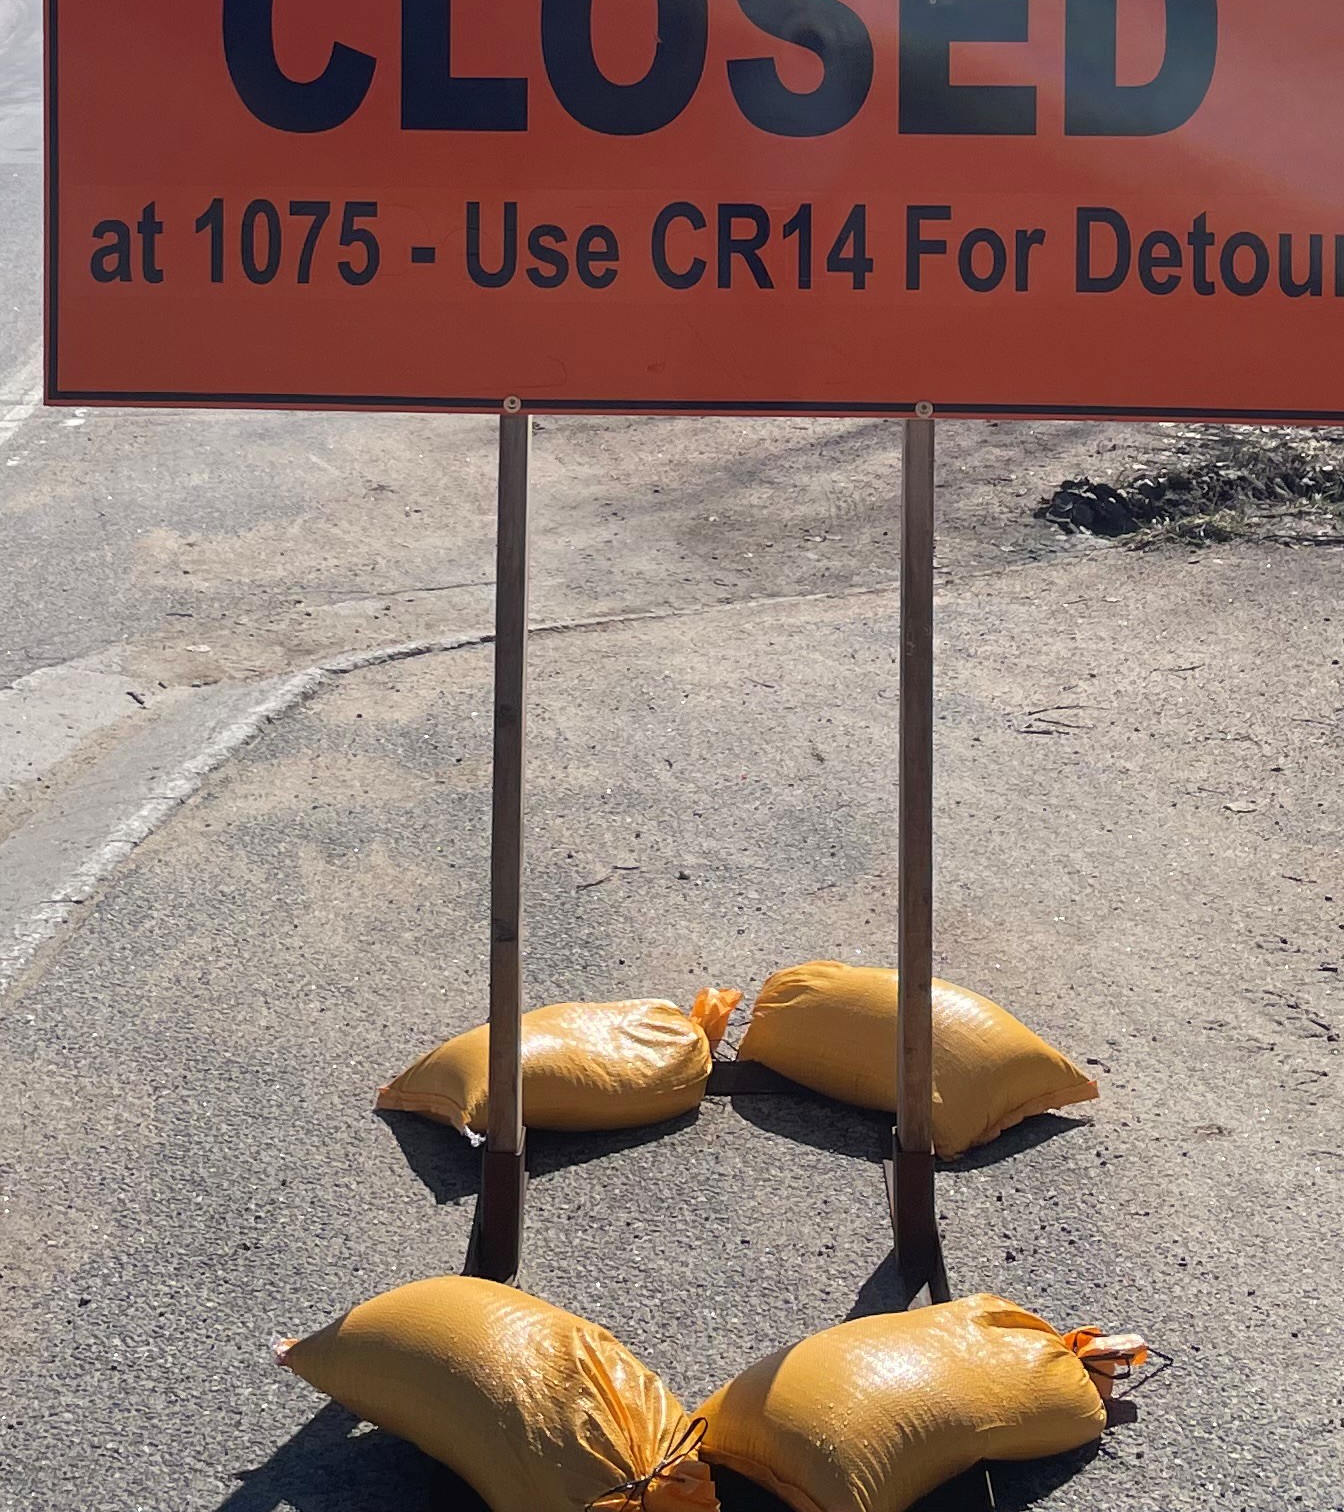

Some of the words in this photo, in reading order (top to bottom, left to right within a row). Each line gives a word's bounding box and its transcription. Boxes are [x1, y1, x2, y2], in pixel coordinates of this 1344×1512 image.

[89, 202, 164, 285] at
[194, 198, 380, 286] 1075
[466, 202, 619, 289] Use
[651, 201, 873, 291] CR14
[906, 205, 1045, 293] For
